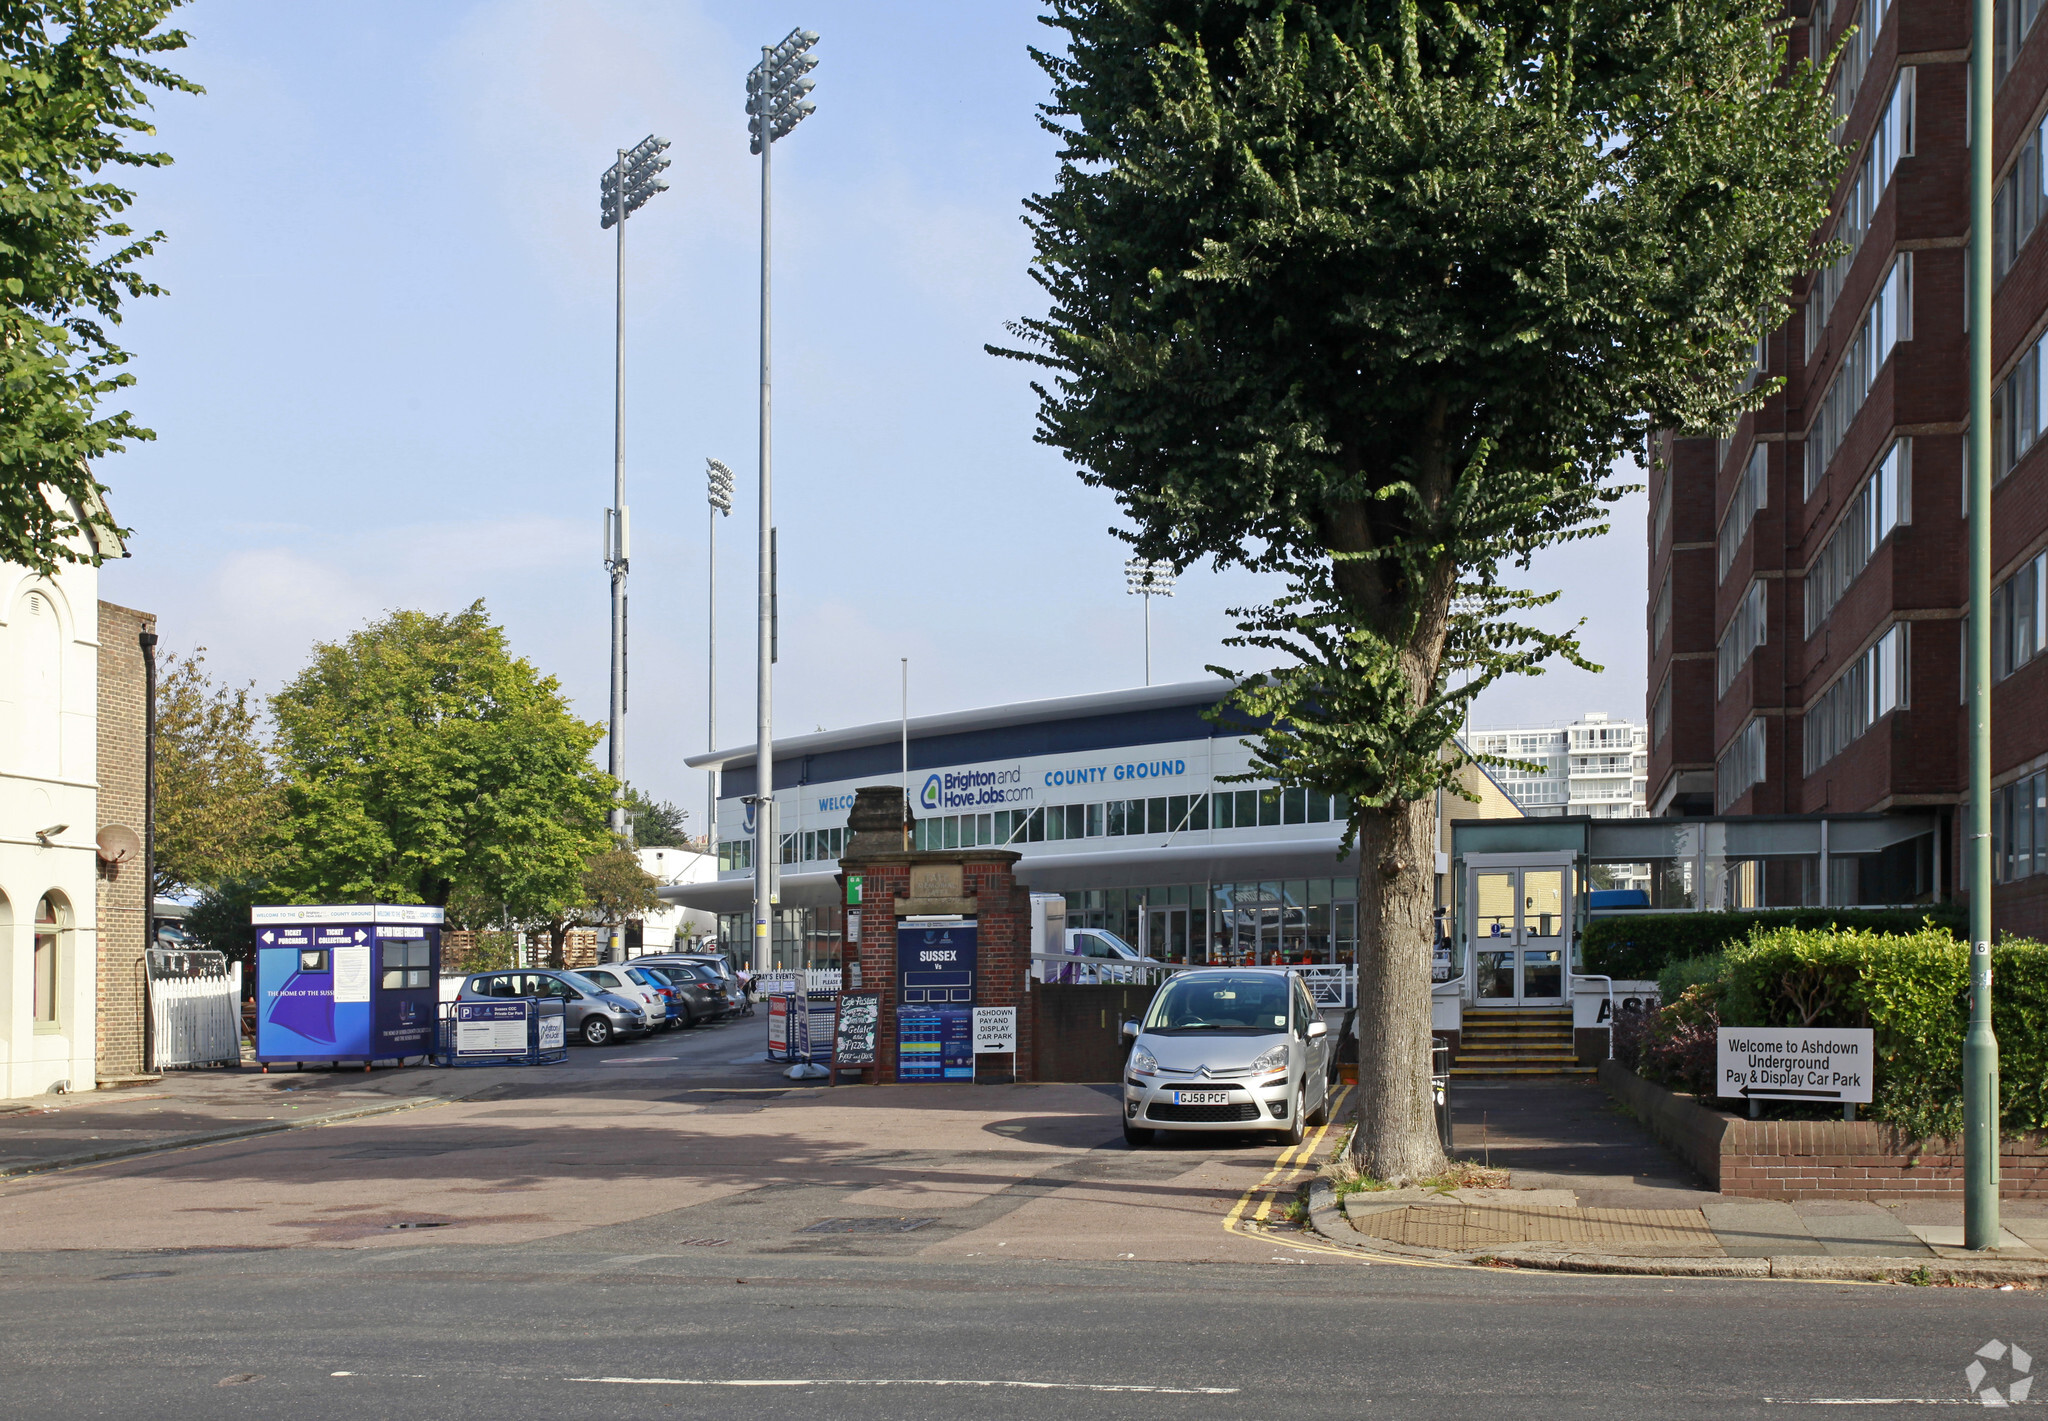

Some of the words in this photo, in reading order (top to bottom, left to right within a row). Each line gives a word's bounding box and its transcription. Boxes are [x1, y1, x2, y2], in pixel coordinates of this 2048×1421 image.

[945, 770, 996, 791] Brighton
[998, 765, 1020, 784] and
[1045, 766, 1107, 786] COUNTY
[1114, 760, 1186, 780] GROUND
[1978, 943, 1985, 952] 6
[920, 951, 956, 961] SUSSEX
[463, 1009, 469, 1017] P
[848, 1025, 873, 1034] Gelato
[1728, 1039, 1782, 1054] Welcome
[1786, 1041, 1798, 1054] to
[1801, 1039, 1858, 1055] Ashdown
[1748, 1054, 1830, 1072] Underground
[1726, 1070, 1746, 1086] Pay
[1750, 1070, 1758, 1084] &
[1760, 1070, 1803, 1087] Display
[1806, 1072, 1829, 1086] Car
[1832, 1072, 1860, 1087] Park
[1180, 1093, 1205, 1104] GJ58
[1208, 1093, 1226, 1103] PCF
